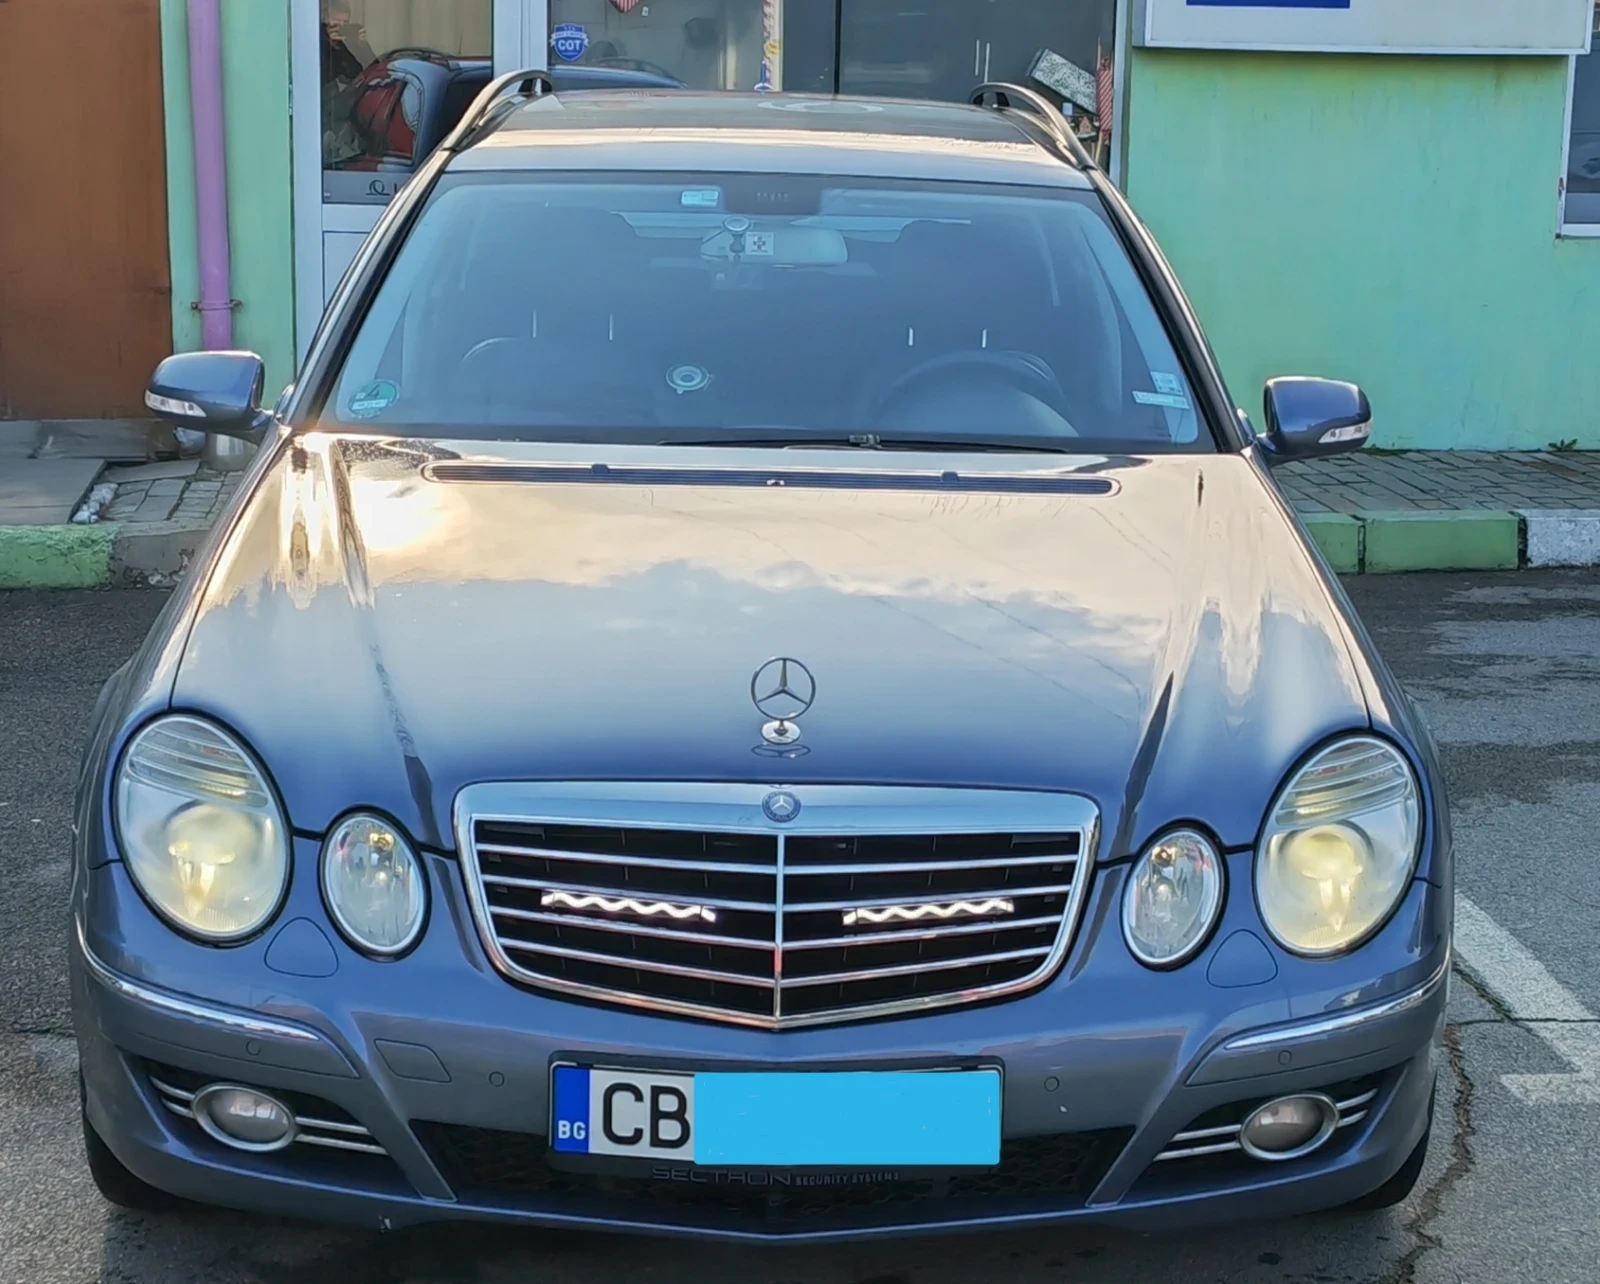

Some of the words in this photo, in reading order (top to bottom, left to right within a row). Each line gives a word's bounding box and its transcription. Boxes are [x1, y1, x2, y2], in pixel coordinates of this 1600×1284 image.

[602, 1082, 691, 1149] CB
[558, 1121, 586, 1140] BG
[652, 1166, 791, 1185] SECTRON
[796, 1176, 847, 1186] SECURITY
